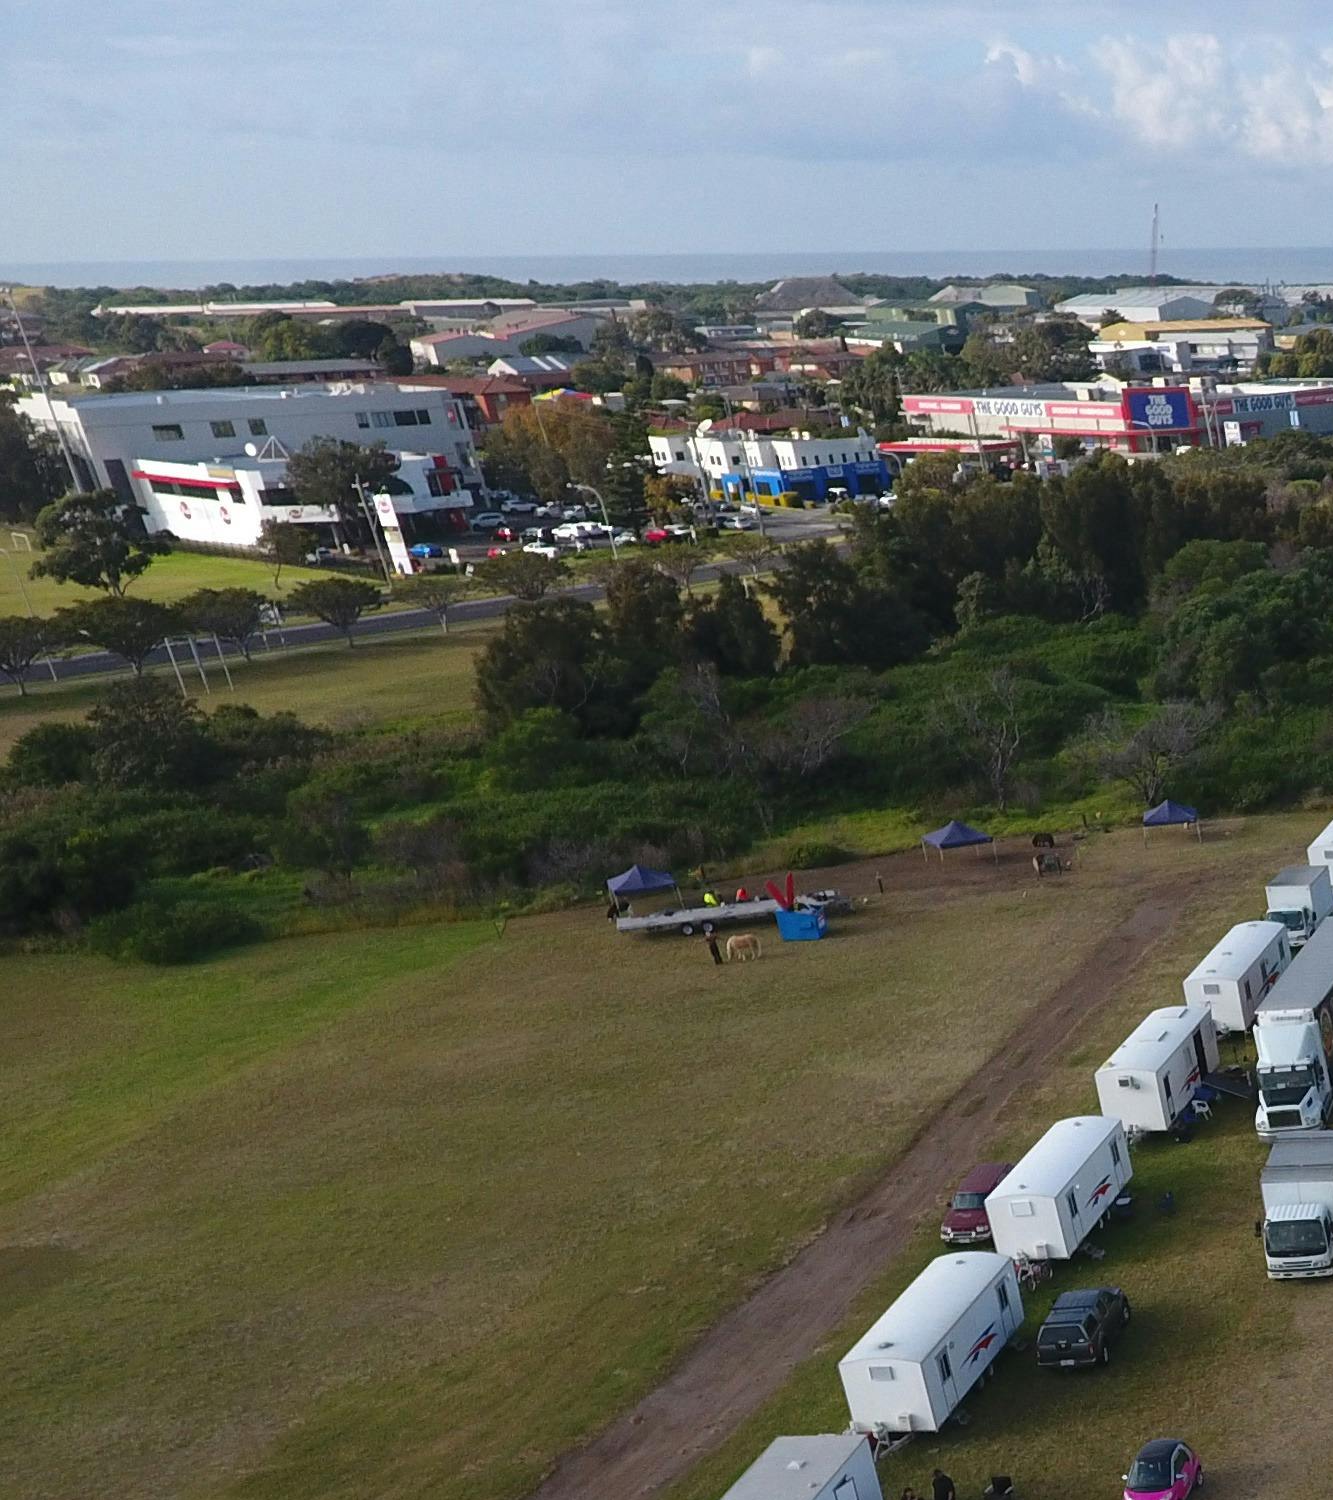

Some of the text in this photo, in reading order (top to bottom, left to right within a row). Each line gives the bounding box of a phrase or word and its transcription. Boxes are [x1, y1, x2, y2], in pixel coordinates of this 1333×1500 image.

[1148, 395, 1166, 405] THE
[1234, 399, 1248, 412] THE
[1250, 396, 1272, 411] GOOD
[976, 401, 992, 413] THE
[994, 402, 1018, 415] GOOD
[1020, 402, 1043, 416] GUYS
[1145, 404, 1173, 415] GOOD
[1148, 415, 1173, 425] GUYS
